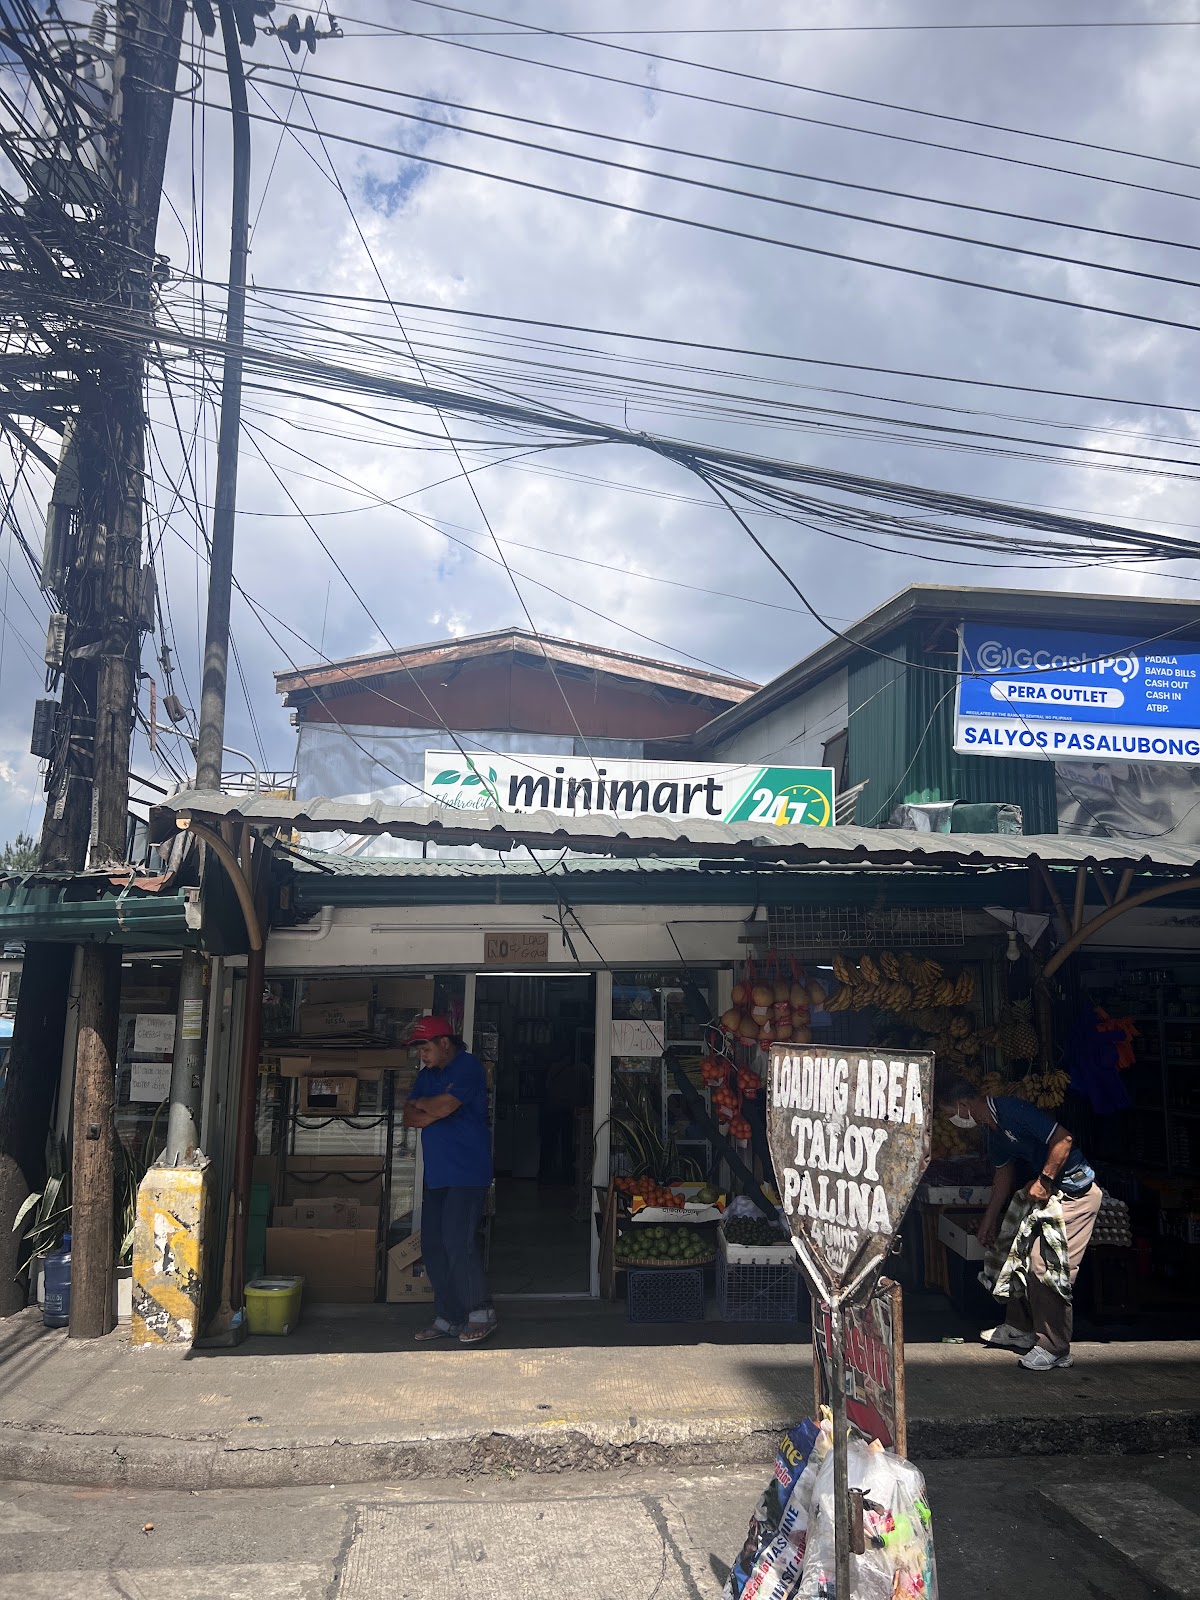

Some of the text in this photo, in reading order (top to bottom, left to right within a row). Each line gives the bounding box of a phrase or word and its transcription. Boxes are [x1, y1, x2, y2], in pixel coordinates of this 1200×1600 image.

[1144, 655, 1178, 665] PADALA
[1144, 667, 1197, 678] BAYAD BILLS
[1144, 678, 1189, 690] CASH OUT
[1007, 685, 1108, 703] PERA OUTLET
[1145, 690, 1182, 701] CASH IN
[1146, 703, 1170, 713] ATBP.
[964, 727, 1200, 757] SALYOS PASALUBONG
[508, 766, 723, 816] minimart
[487, 939, 508, 958] NO
[522, 934, 546, 946] LOAD
[612, 1022, 634, 1052] NO
[772, 1055, 924, 1125] LOADING AREA
[790, 1115, 889, 1182] TALOY
[783, 1167, 893, 1235] PALINA
